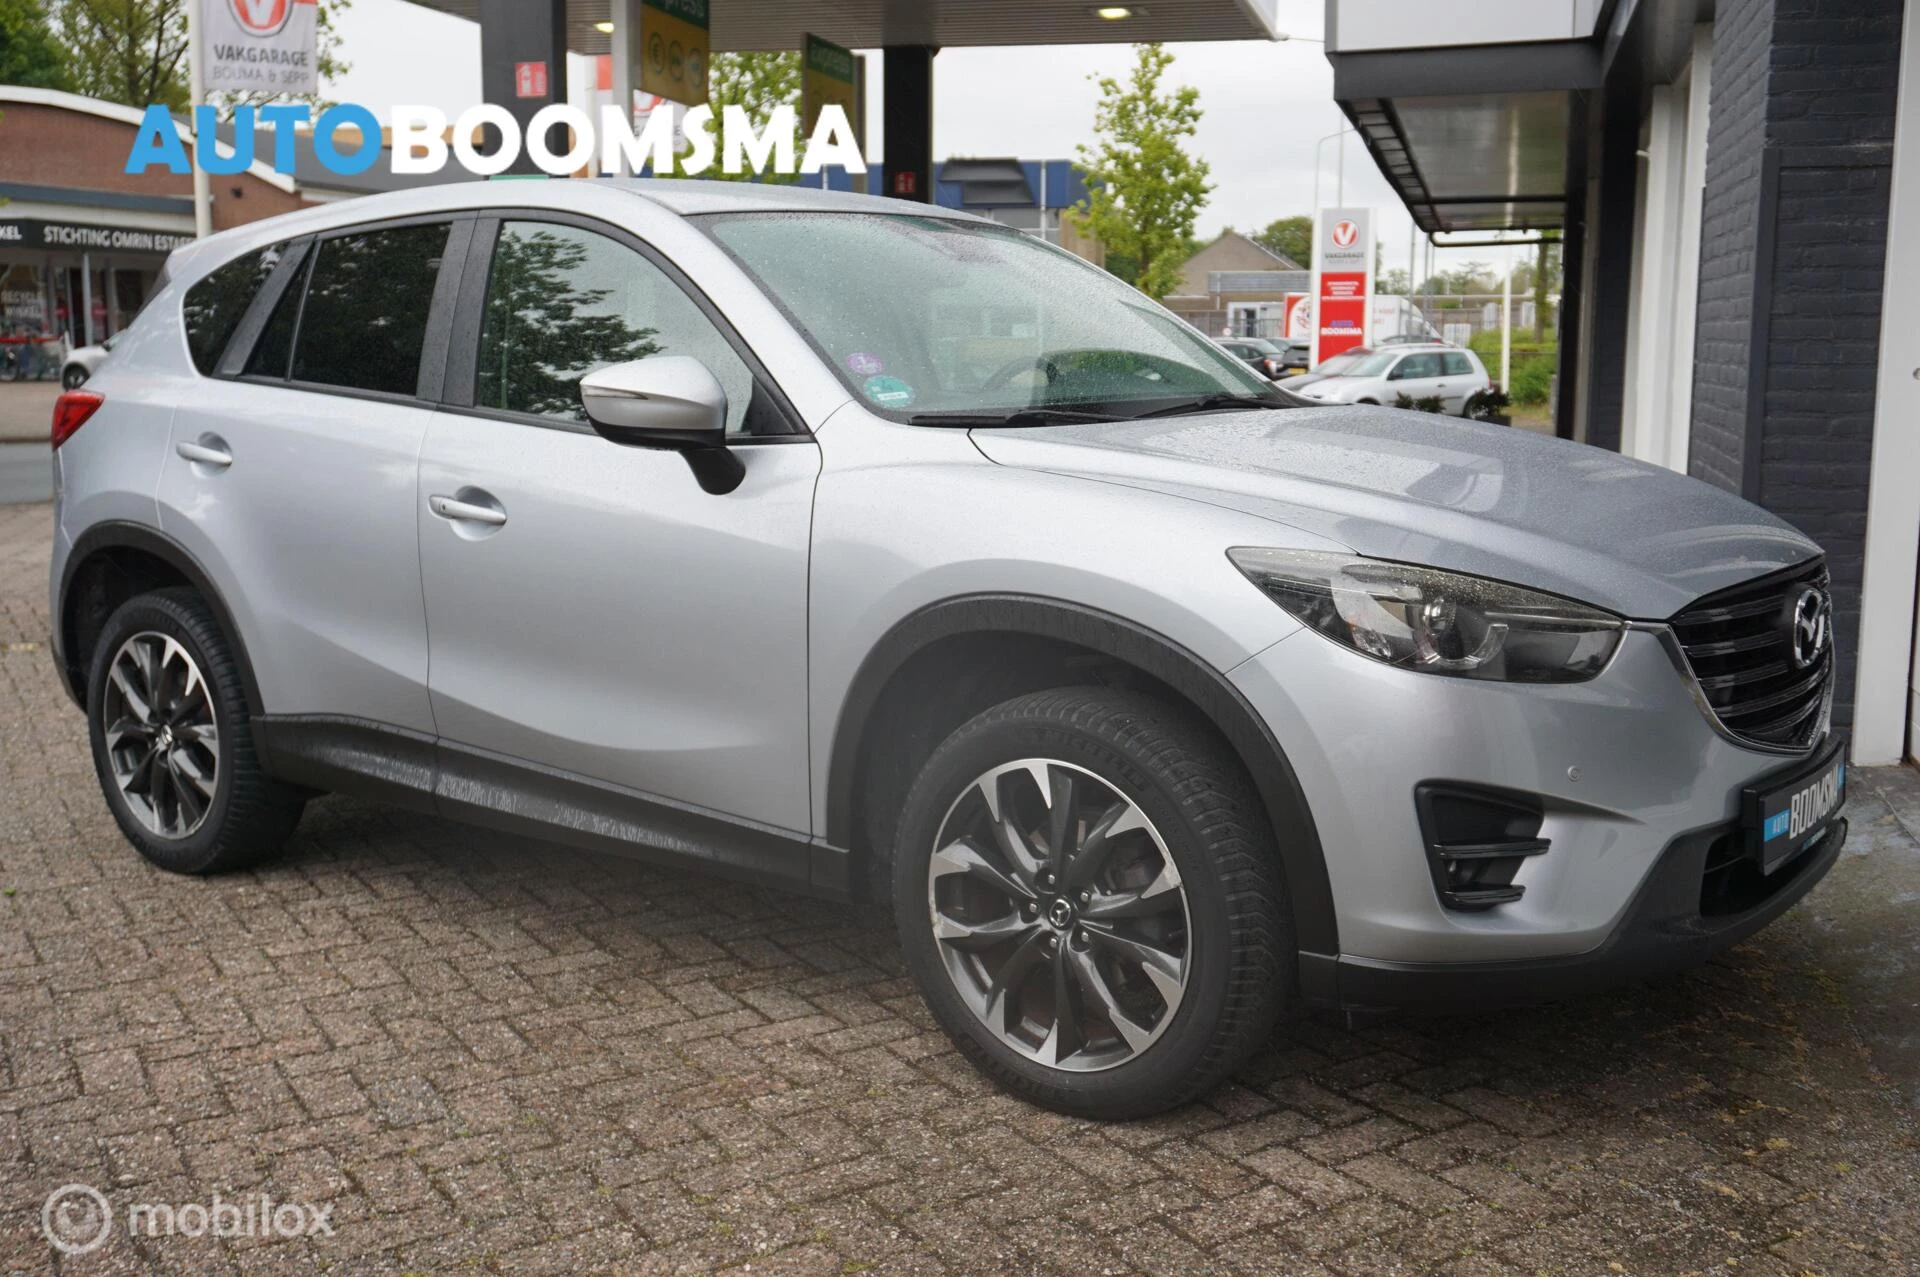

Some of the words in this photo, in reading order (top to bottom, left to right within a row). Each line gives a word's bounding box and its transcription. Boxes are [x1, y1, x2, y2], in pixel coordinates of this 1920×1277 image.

[213, 44, 309, 66] VAKGARAGE
[43, 225, 111, 247] STICHTING
[111, 230, 153, 249] OMRIN
